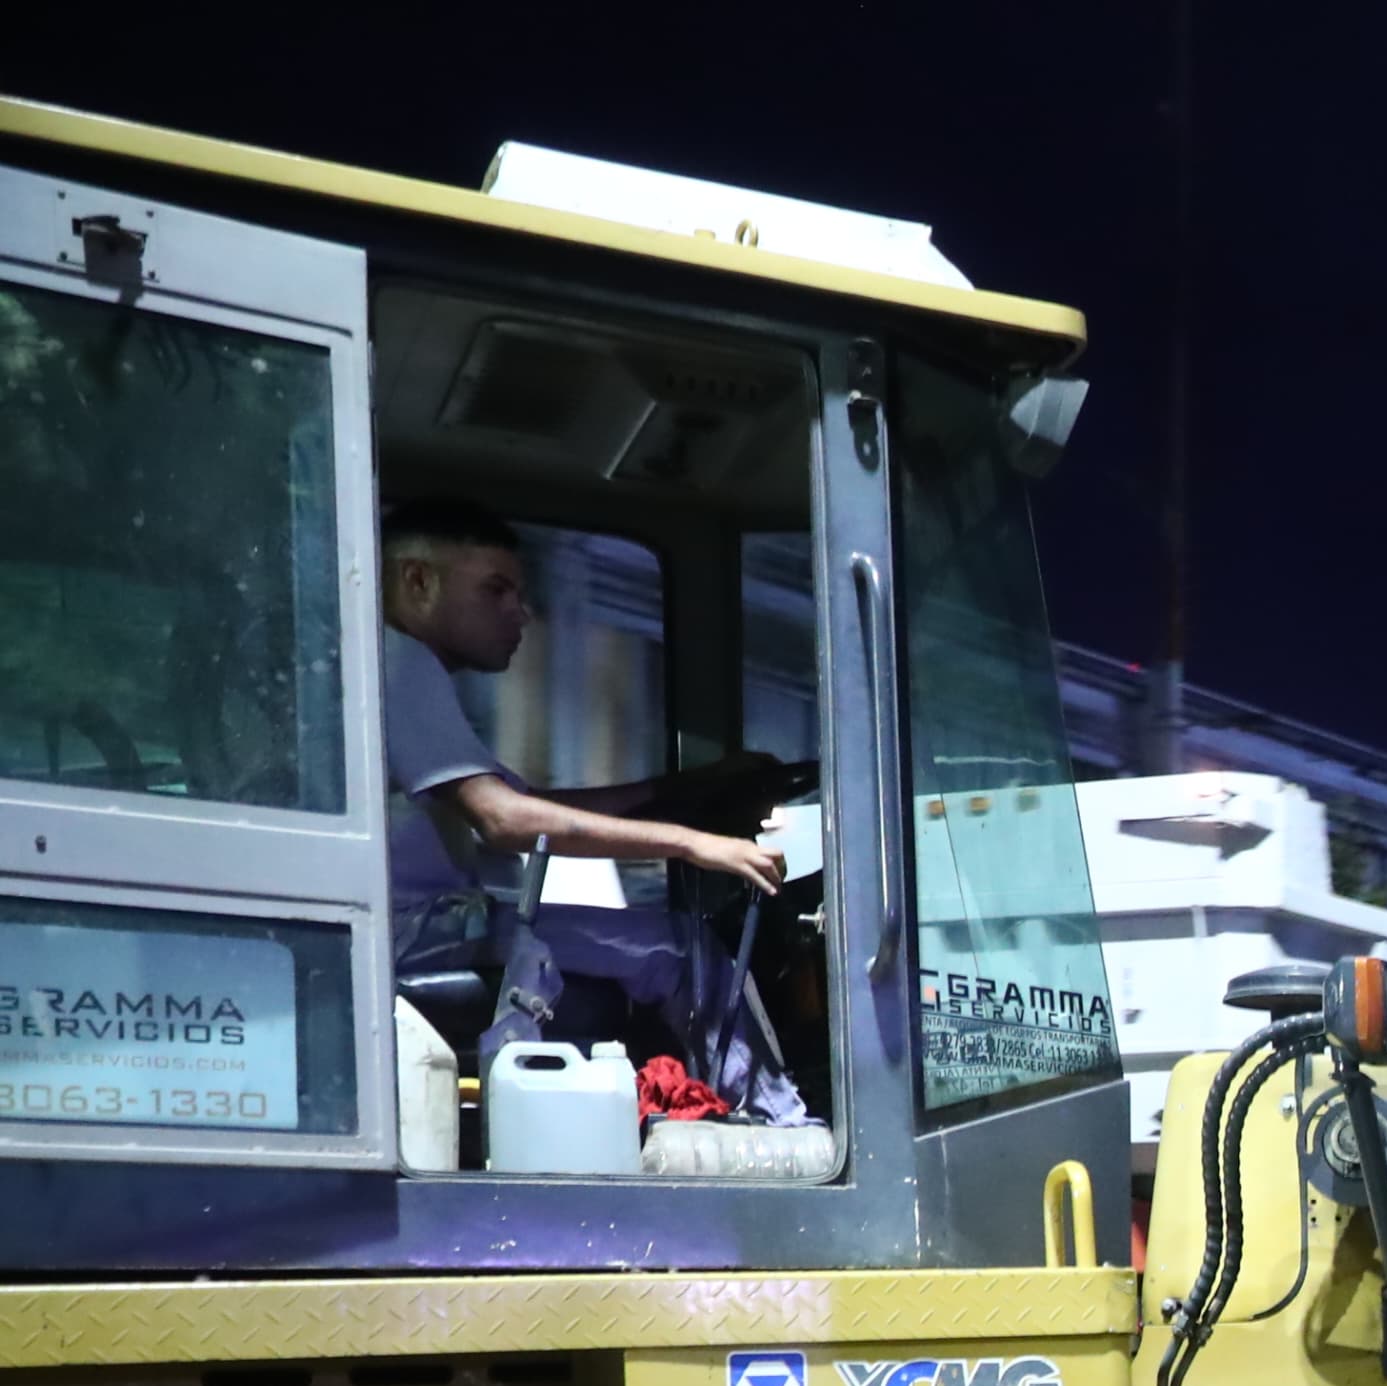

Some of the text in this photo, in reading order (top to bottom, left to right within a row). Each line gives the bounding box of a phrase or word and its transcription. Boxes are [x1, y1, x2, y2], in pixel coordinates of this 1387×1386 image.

[0, 986, 246, 1022] GRAMMA
[947, 973, 1109, 1019] GRAMMA
[950, 999, 1112, 1034] SERVICIOS
